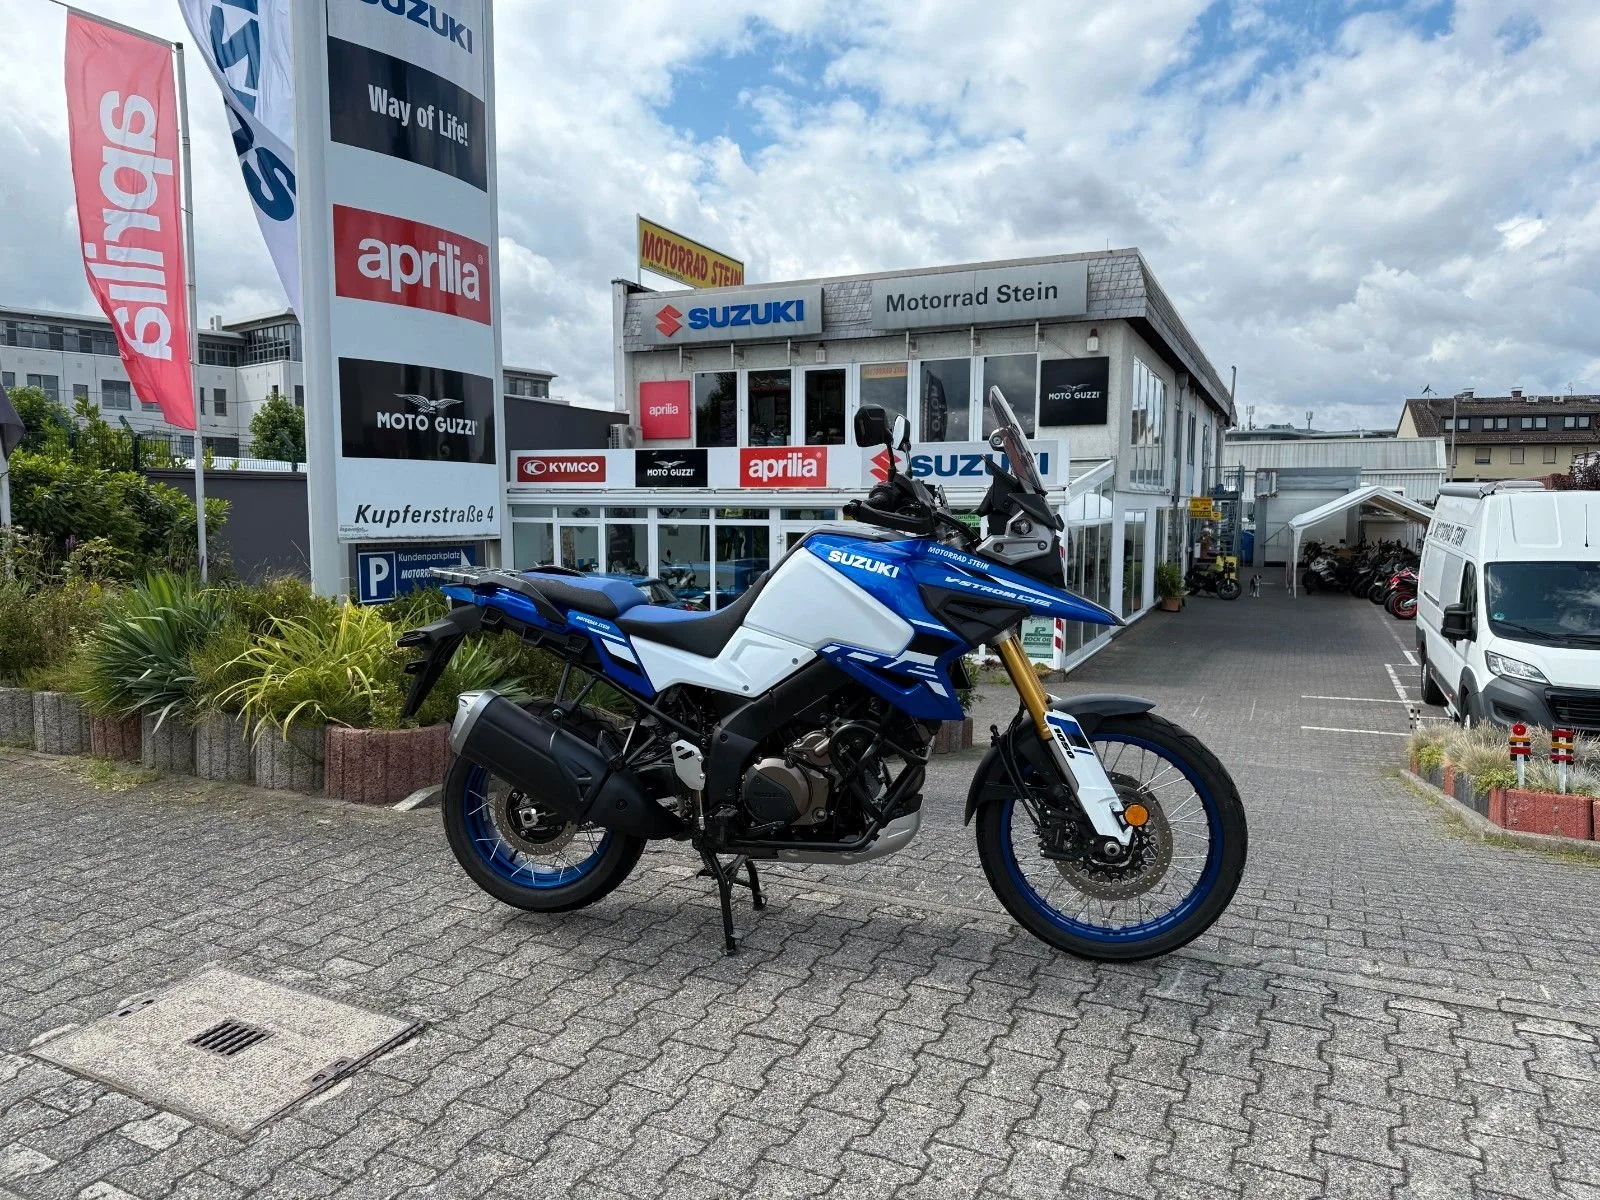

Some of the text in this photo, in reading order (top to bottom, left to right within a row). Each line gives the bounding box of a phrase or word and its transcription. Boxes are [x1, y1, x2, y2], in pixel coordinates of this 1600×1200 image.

[360, 0, 473, 54] UZUKI
[368, 84, 468, 146] Way of Life!
[357, 237, 480, 301] aprilia
[641, 230, 742, 287] MOTORRAD STEIN
[886, 282, 1058, 313] Motorrad Stein
[688, 300, 804, 330] SUZUKI
[649, 402, 679, 416] aprilia
[377, 412, 476, 436] MOTO GUZZI
[549, 462, 599, 473] KYMCO
[647, 468, 693, 477] MOTO GUZZI
[749, 452, 817, 482] aprilia
[911, 452, 1049, 477] SUZUI
[355, 504, 494, 528] Kupferstraße 4
[398, 551, 460, 563] Kundenparkplatz
[827, 550, 900, 579] SUZUKI
[927, 546, 990, 570] MOTORRAD STEIN
[369, 557, 389, 597] P
[401, 568, 432, 579] MOTORR
[945, 576, 1017, 599] V-STROM
[1054, 727, 1075, 759] 1050
